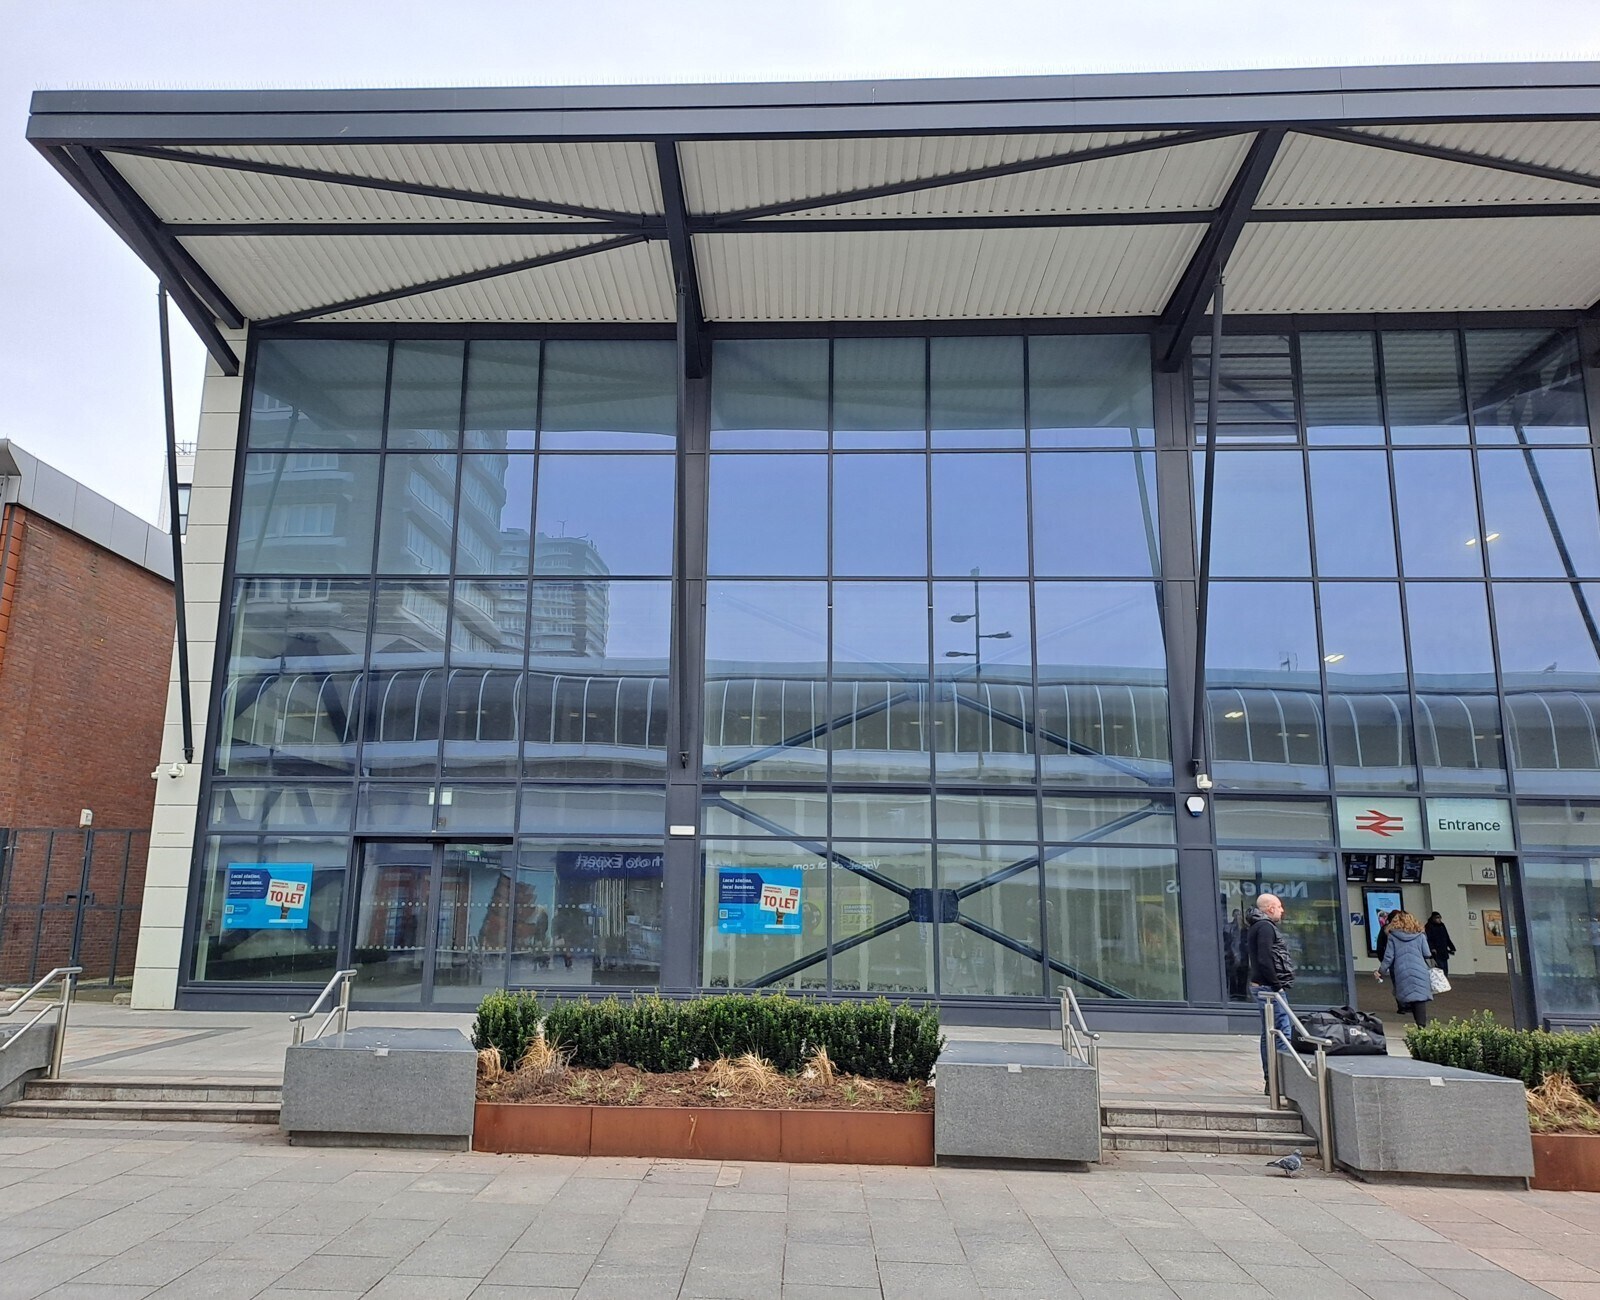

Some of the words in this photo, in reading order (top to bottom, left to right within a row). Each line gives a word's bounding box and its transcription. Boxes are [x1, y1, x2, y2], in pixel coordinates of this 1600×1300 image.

[1438, 818, 1501, 831] Entrance
[270, 890, 283, 902] TO
[285, 892, 304, 904] LET
[764, 895, 777, 907] TO
[779, 897, 798, 910] LET
